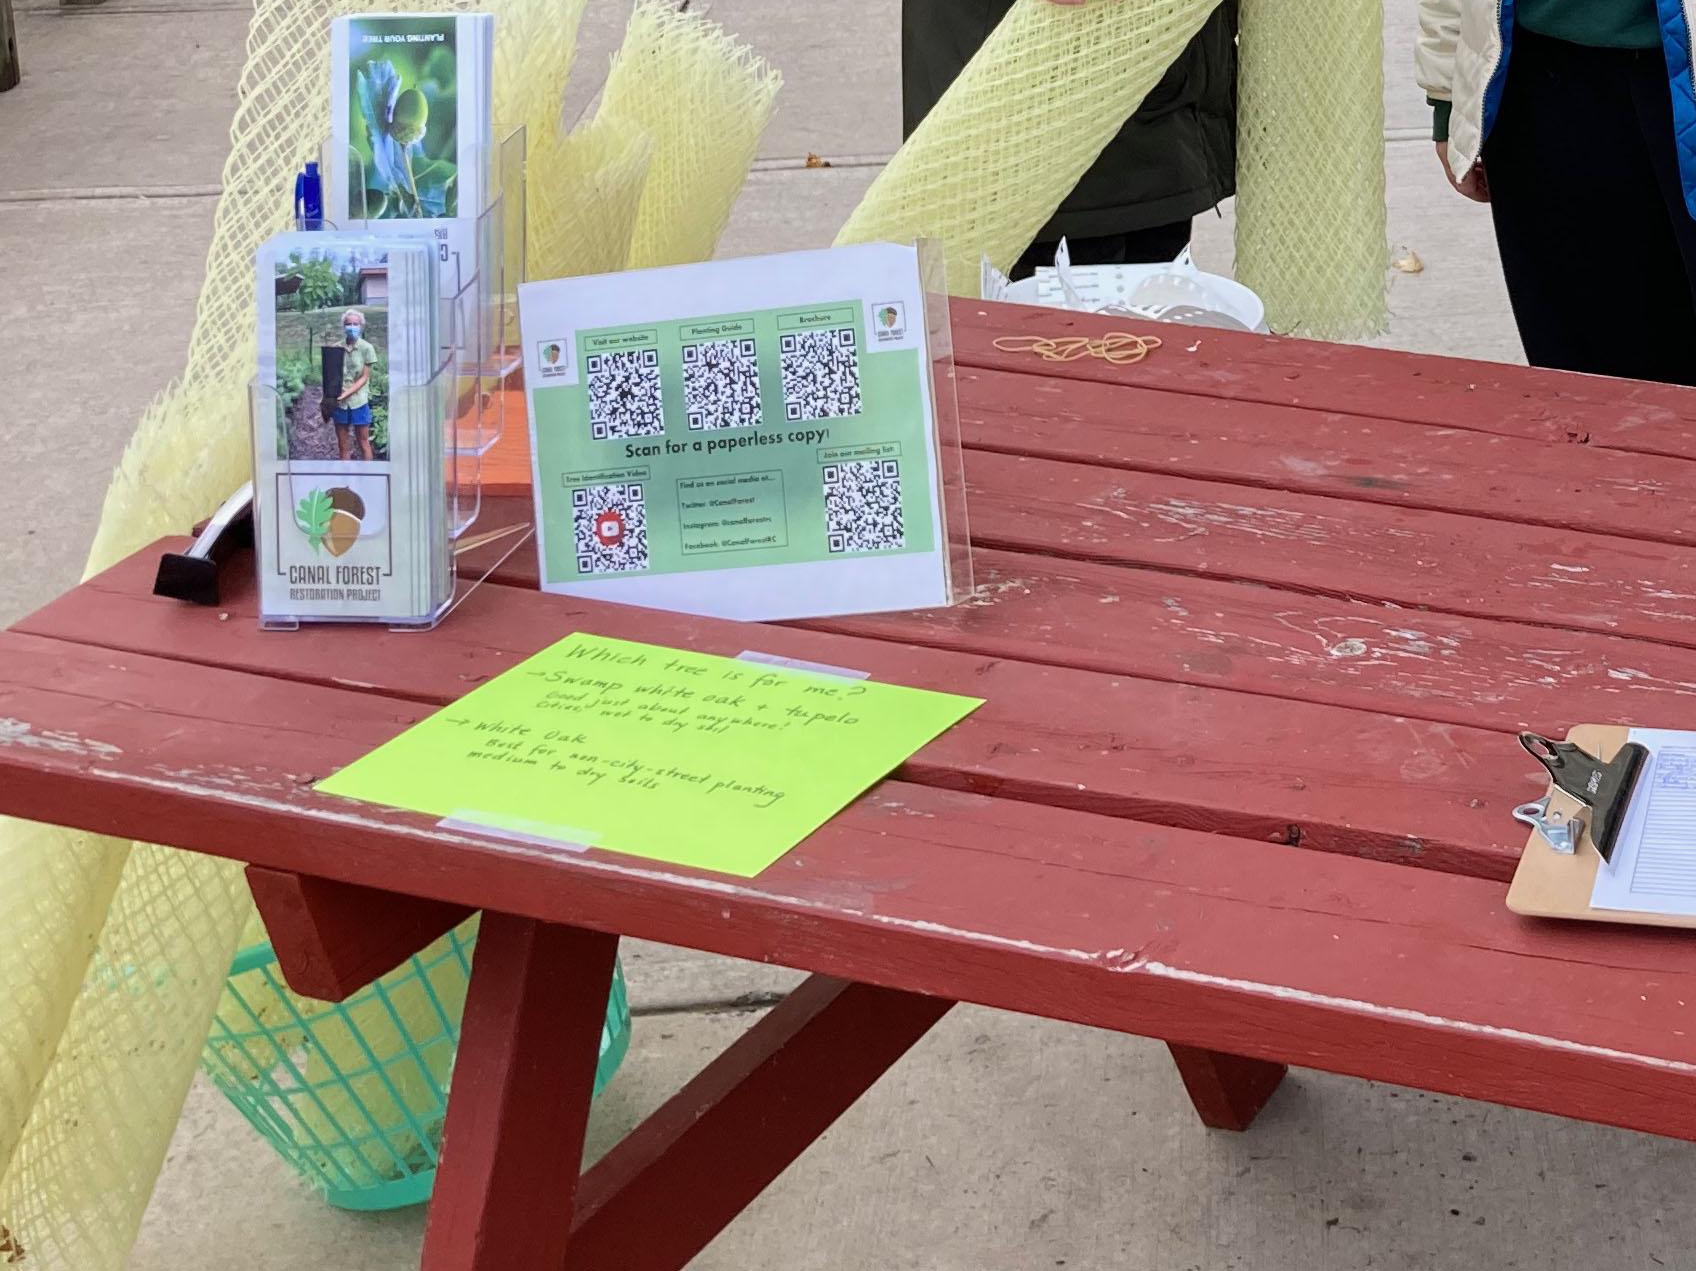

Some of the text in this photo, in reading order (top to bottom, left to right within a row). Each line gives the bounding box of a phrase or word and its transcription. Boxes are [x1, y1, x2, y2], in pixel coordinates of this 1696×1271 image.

[361, 33, 445, 44] PLANTING YOUR TREE
[799, 314, 831, 324] Brochure
[622, 334, 649, 343] website
[625, 428, 830, 458] Scan for a paperless copy!
[289, 565, 382, 586] CANAL FOREST
[289, 587, 381, 602] RESTORATION PROJECT
[566, 643, 648, 668] Which
[663, 658, 708, 677] tree
[721, 670, 744, 682] is
[750, 672, 787, 689] for
[545, 670, 623, 694] Swamp
[634, 684, 695, 701] white
[702, 693, 745, 708] oak
[785, 704, 859, 727] tupelo
[637, 702, 690, 716] about
[473, 720, 532, 737] White
[466, 748, 538, 766] medium
[549, 759, 567, 772] to
[576, 766, 607, 786] dry
[485, 737, 524, 750] Best
[529, 744, 556, 757] for
[705, 779, 785, 809] planting
